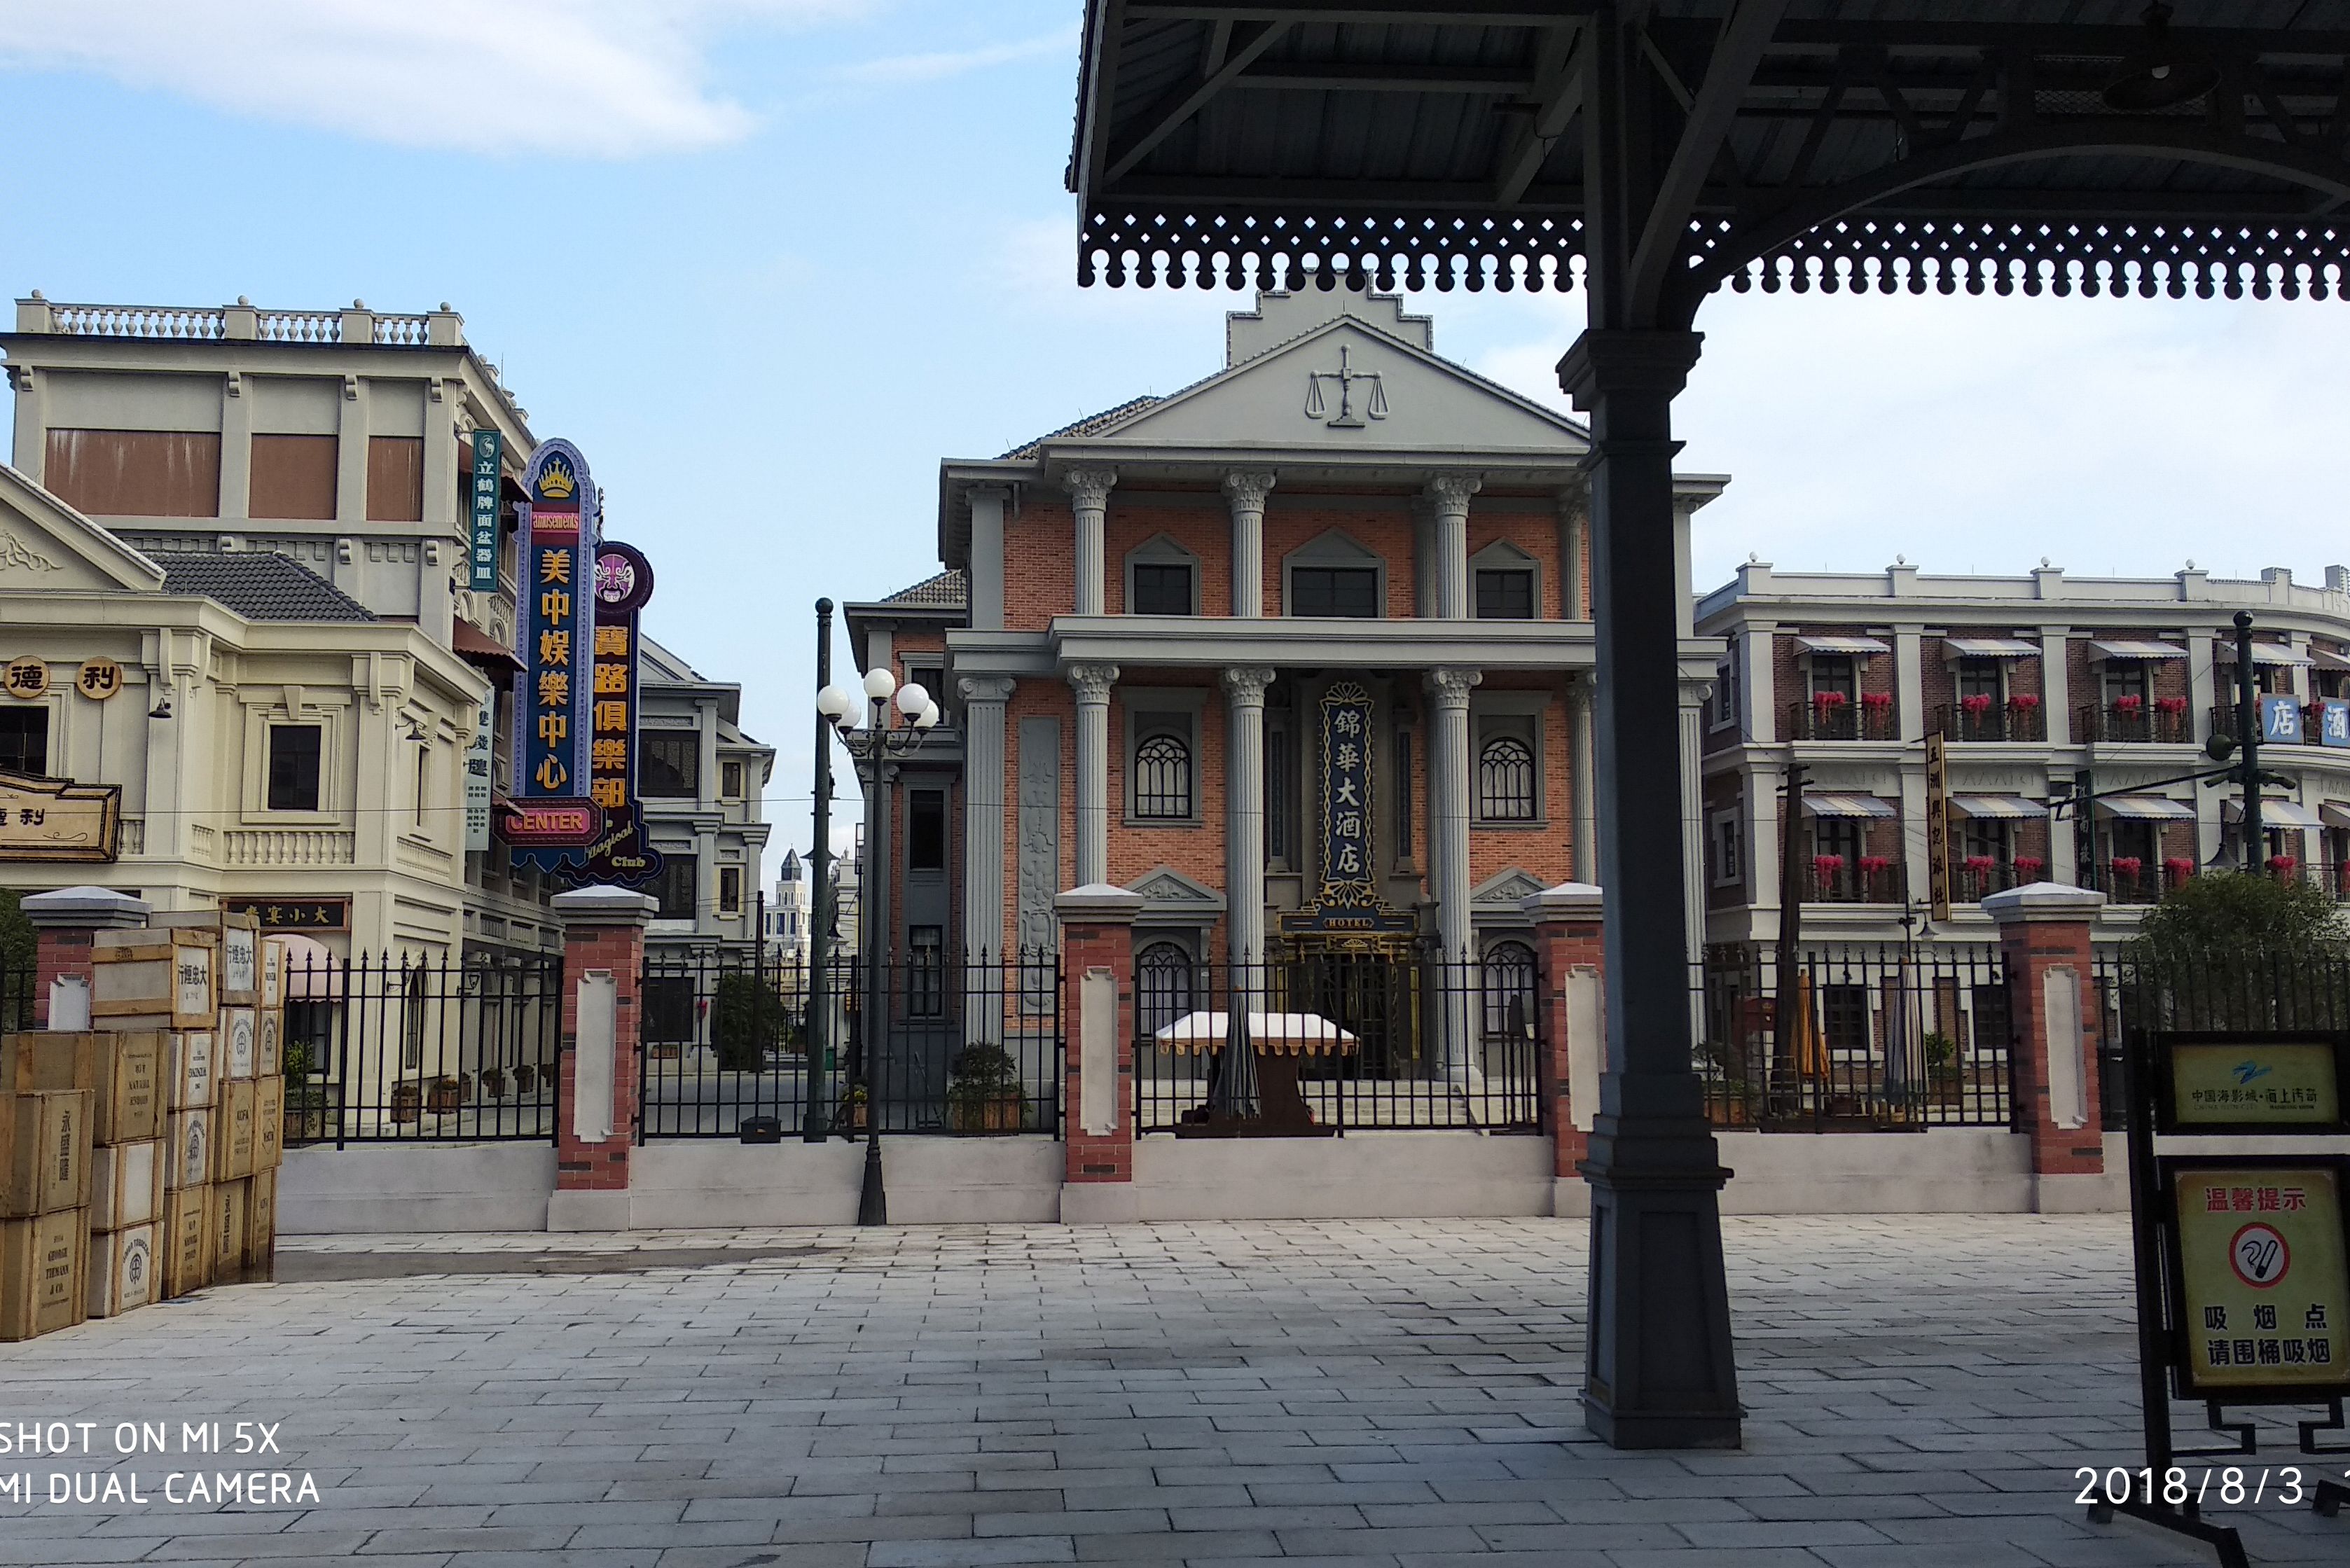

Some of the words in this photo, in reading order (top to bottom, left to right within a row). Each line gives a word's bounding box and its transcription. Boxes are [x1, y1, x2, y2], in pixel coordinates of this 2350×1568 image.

[475, 459, 495, 581] 立鶴牌面盆器皿
[533, 513, 579, 529] amusements
[1334, 709, 1361, 875] 錦華大酒店
[510, 812, 583, 830] CENTER
[611, 856, 646, 867] Club
[1327, 918, 1369, 928] HOTEL
[2206, 1187, 2307, 1214] 温馨提示
[2208, 1338, 2331, 1366] 请围桶吸烟
